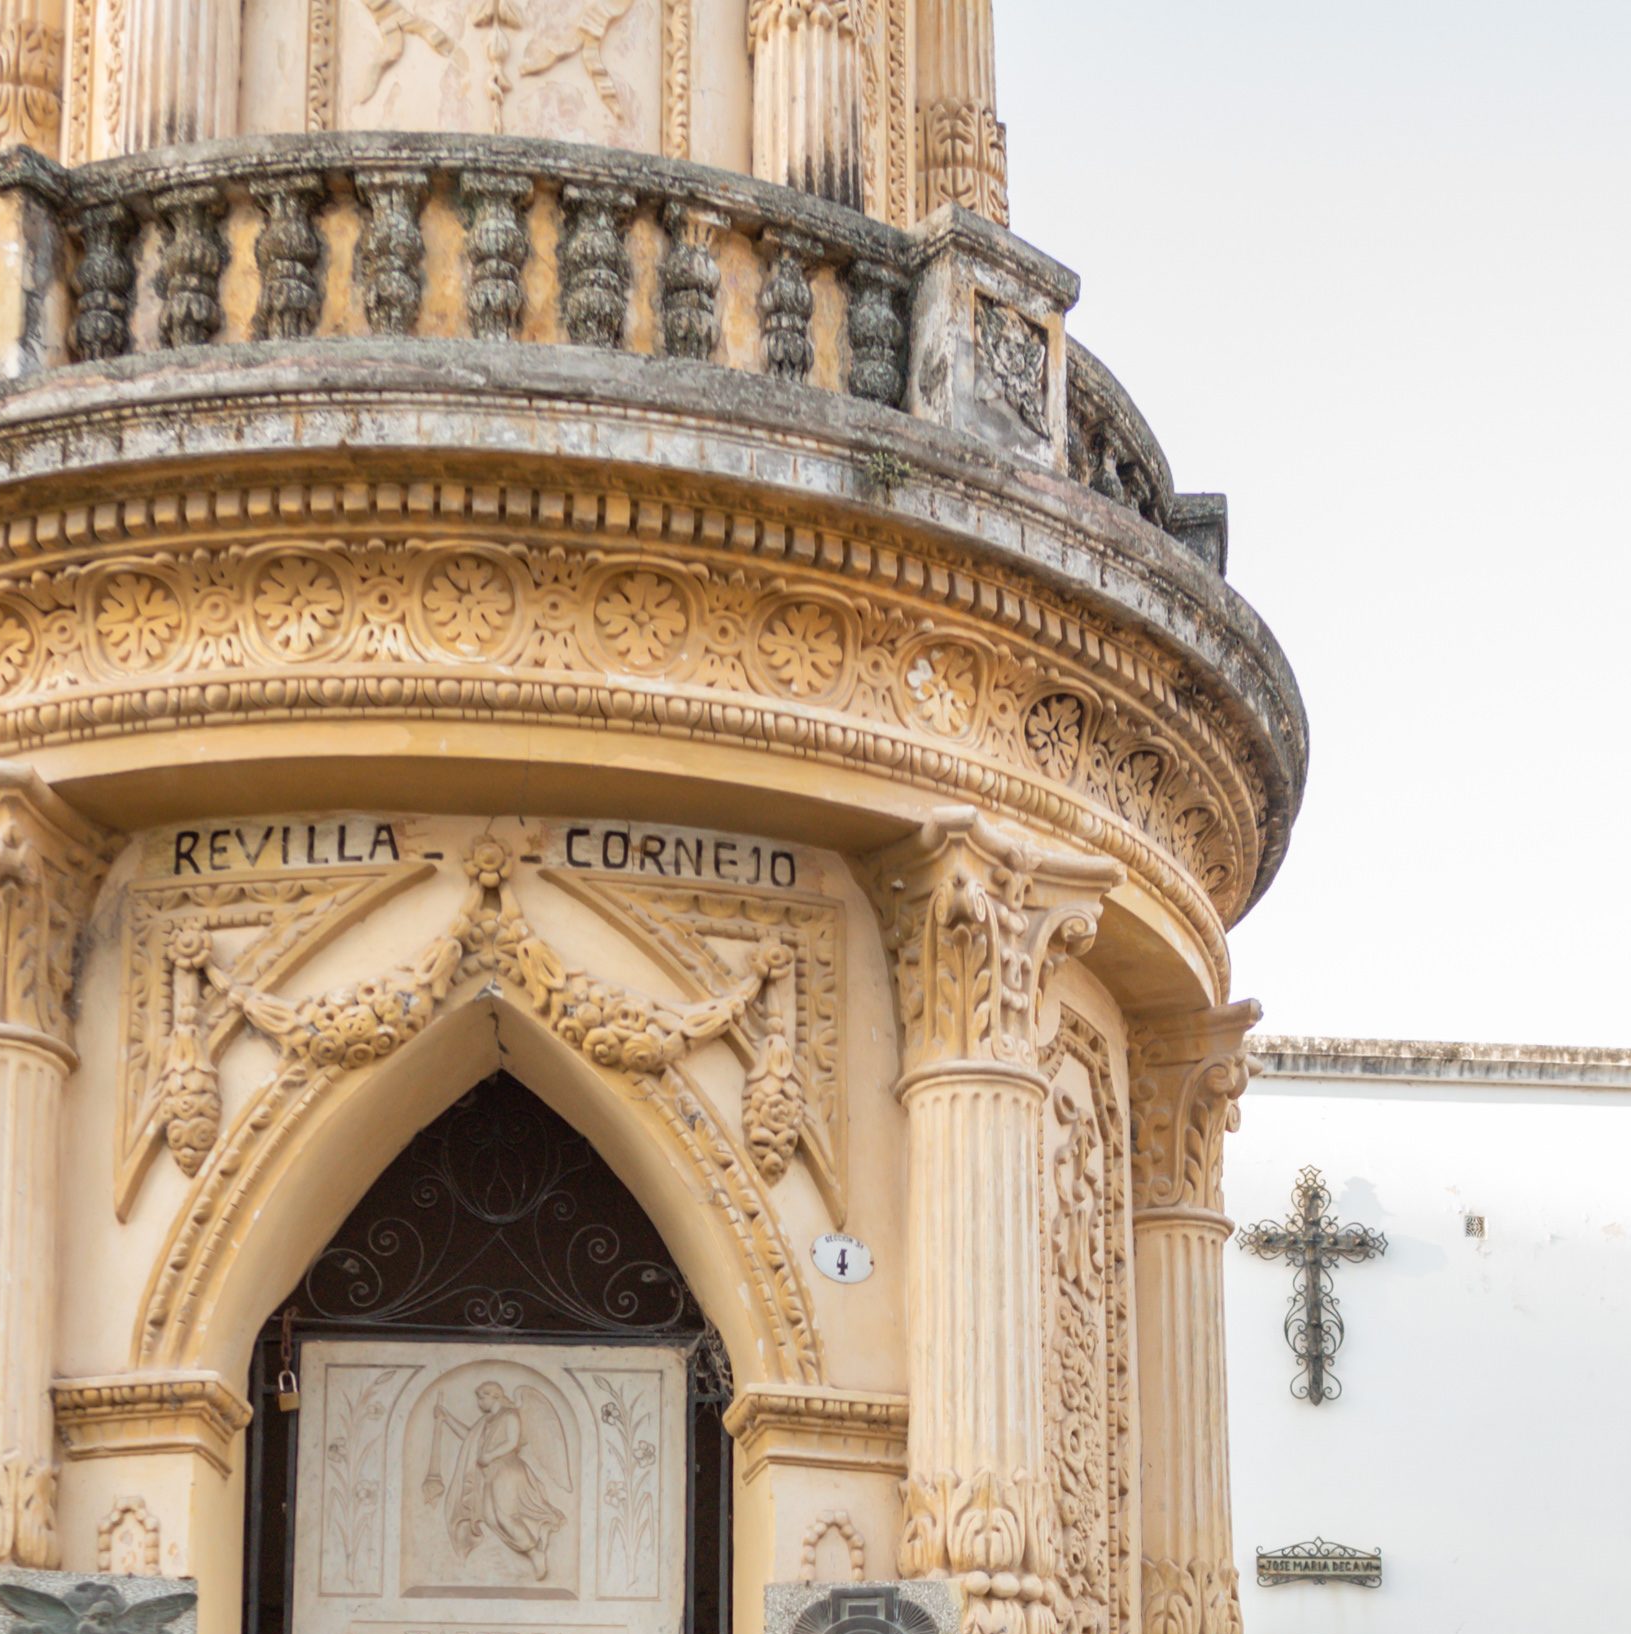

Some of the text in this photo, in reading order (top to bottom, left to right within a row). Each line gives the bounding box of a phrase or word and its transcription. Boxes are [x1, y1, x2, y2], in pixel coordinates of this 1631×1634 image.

[173, 823, 798, 887] REVILLA CORNEJO
[836, 1248, 849, 1276] 4
[1264, 1560, 1290, 1571] JOSE
[1293, 1560, 1329, 1572] MARIA
